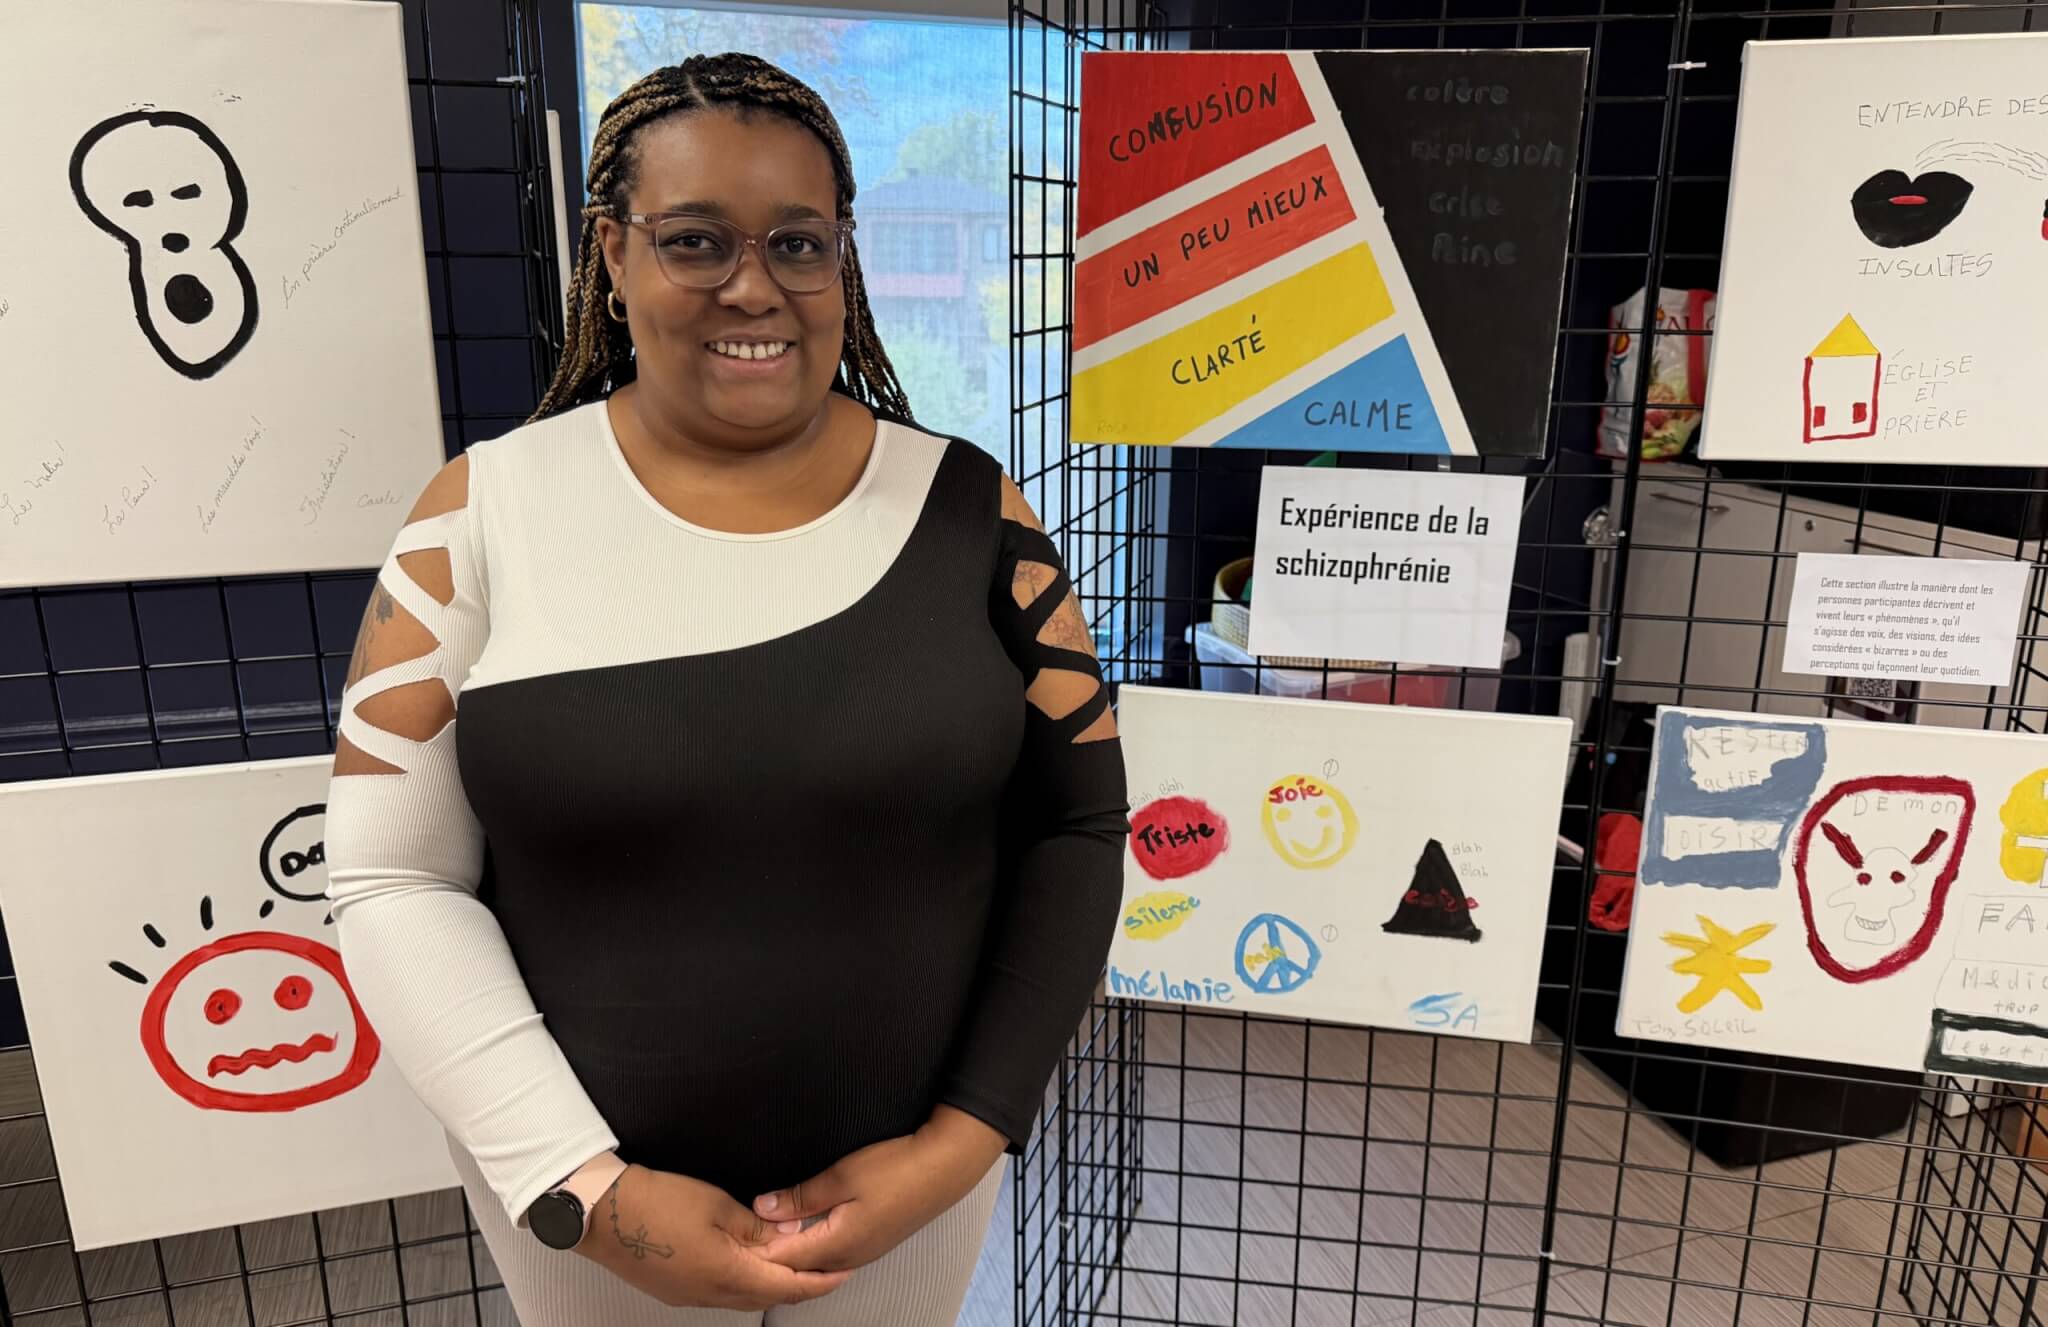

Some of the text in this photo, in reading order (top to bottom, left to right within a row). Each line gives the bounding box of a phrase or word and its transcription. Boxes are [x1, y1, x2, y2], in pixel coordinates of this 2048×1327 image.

[1857, 96, 1993, 128] ENTENDRE
[1124, 252, 1160, 288] UN
[1180, 218, 1230, 261] PEU
[1857, 252, 1994, 280] INSULTES
[1170, 314, 1267, 386] CLARTÉ
[1915, 380, 1949, 402] ET
[1304, 399, 1414, 433] CALME
[1280, 497, 1490, 536] Expérience de la
[1276, 548, 1451, 585] schizophrénie
[1820, 578, 1994, 595] Cette section illustre la manière dont les
[1818, 595, 1976, 610] personnes participantes décrivent et
[1816, 612, 1841, 621] vivent
[1842, 612, 1865, 622] leurs
[1875, 614, 1929, 625] phénomènes
[1850, 627, 1865, 637] des
[1888, 629, 1903, 639] des
[1939, 631, 1955, 642] des
[1957, 632, 1980, 644] idées
[1812, 643, 1863, 654] considérées
[1873, 645, 1909, 656] bizarres
[1932, 648, 1948, 659] des
[1809, 660, 1860, 671] perceptions
[1861, 661, 1875, 672] qui
[1876, 662, 1919, 673] façonnent
[1920, 664, 1939, 673] leur
[1268, 778, 1324, 806] Joie
[1137, 822, 1216, 856] Triste
[1977, 903, 2048, 934] FA
